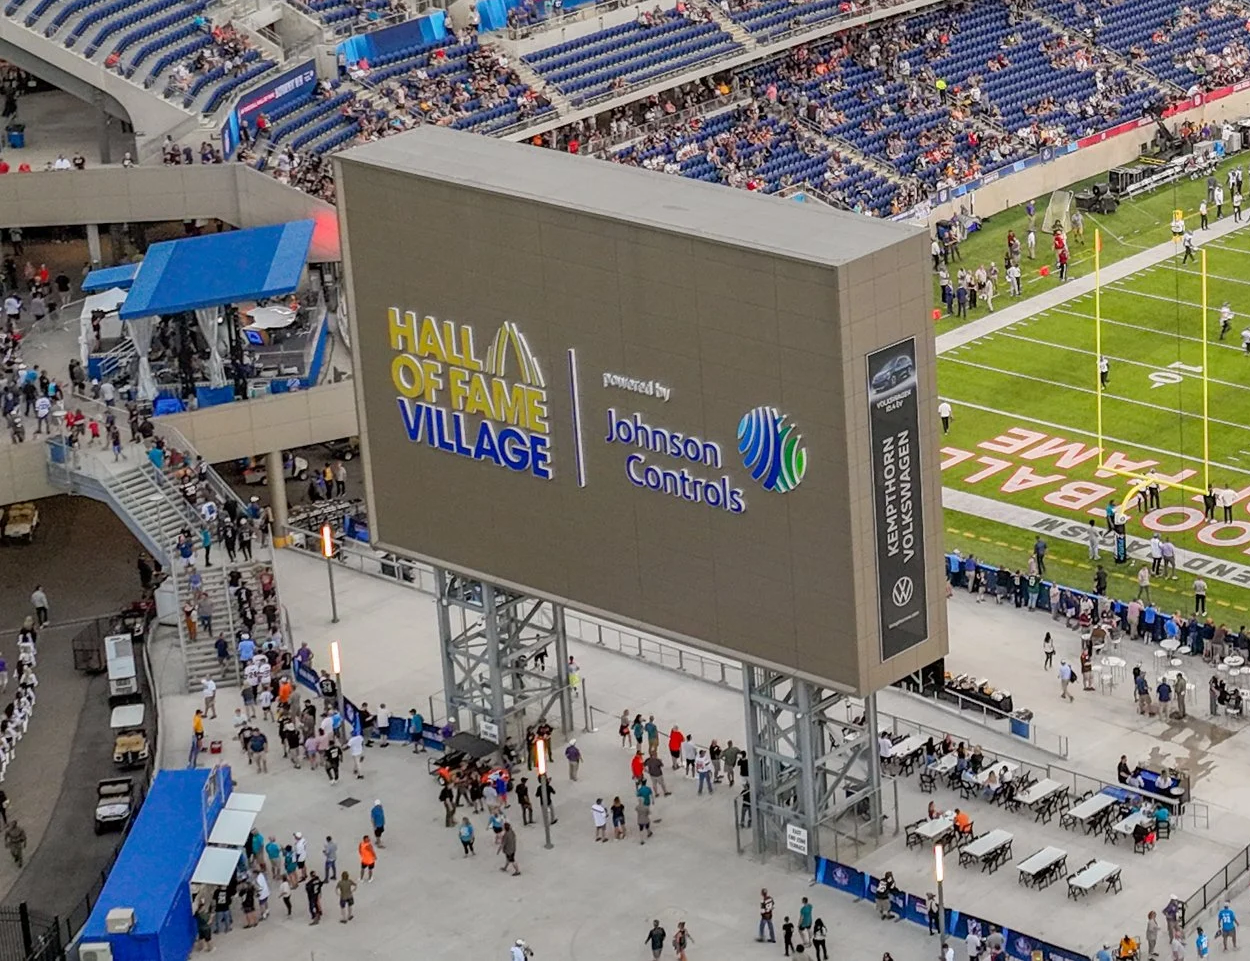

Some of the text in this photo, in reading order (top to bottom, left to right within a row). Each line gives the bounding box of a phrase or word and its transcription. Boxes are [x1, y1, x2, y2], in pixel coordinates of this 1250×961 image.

[388, 307, 483, 372] HALL
[391, 354, 549, 434] OF FAME
[603, 373, 670, 402] powered by
[1149, 361, 1203, 384] 10
[397, 397, 553, 480] VILLAGE
[606, 408, 722, 469] Johnson
[626, 453, 746, 514] Controls
[883, 436, 899, 557] KEMPTHORN
[898, 430, 914, 564] VOLKSWAGEN
